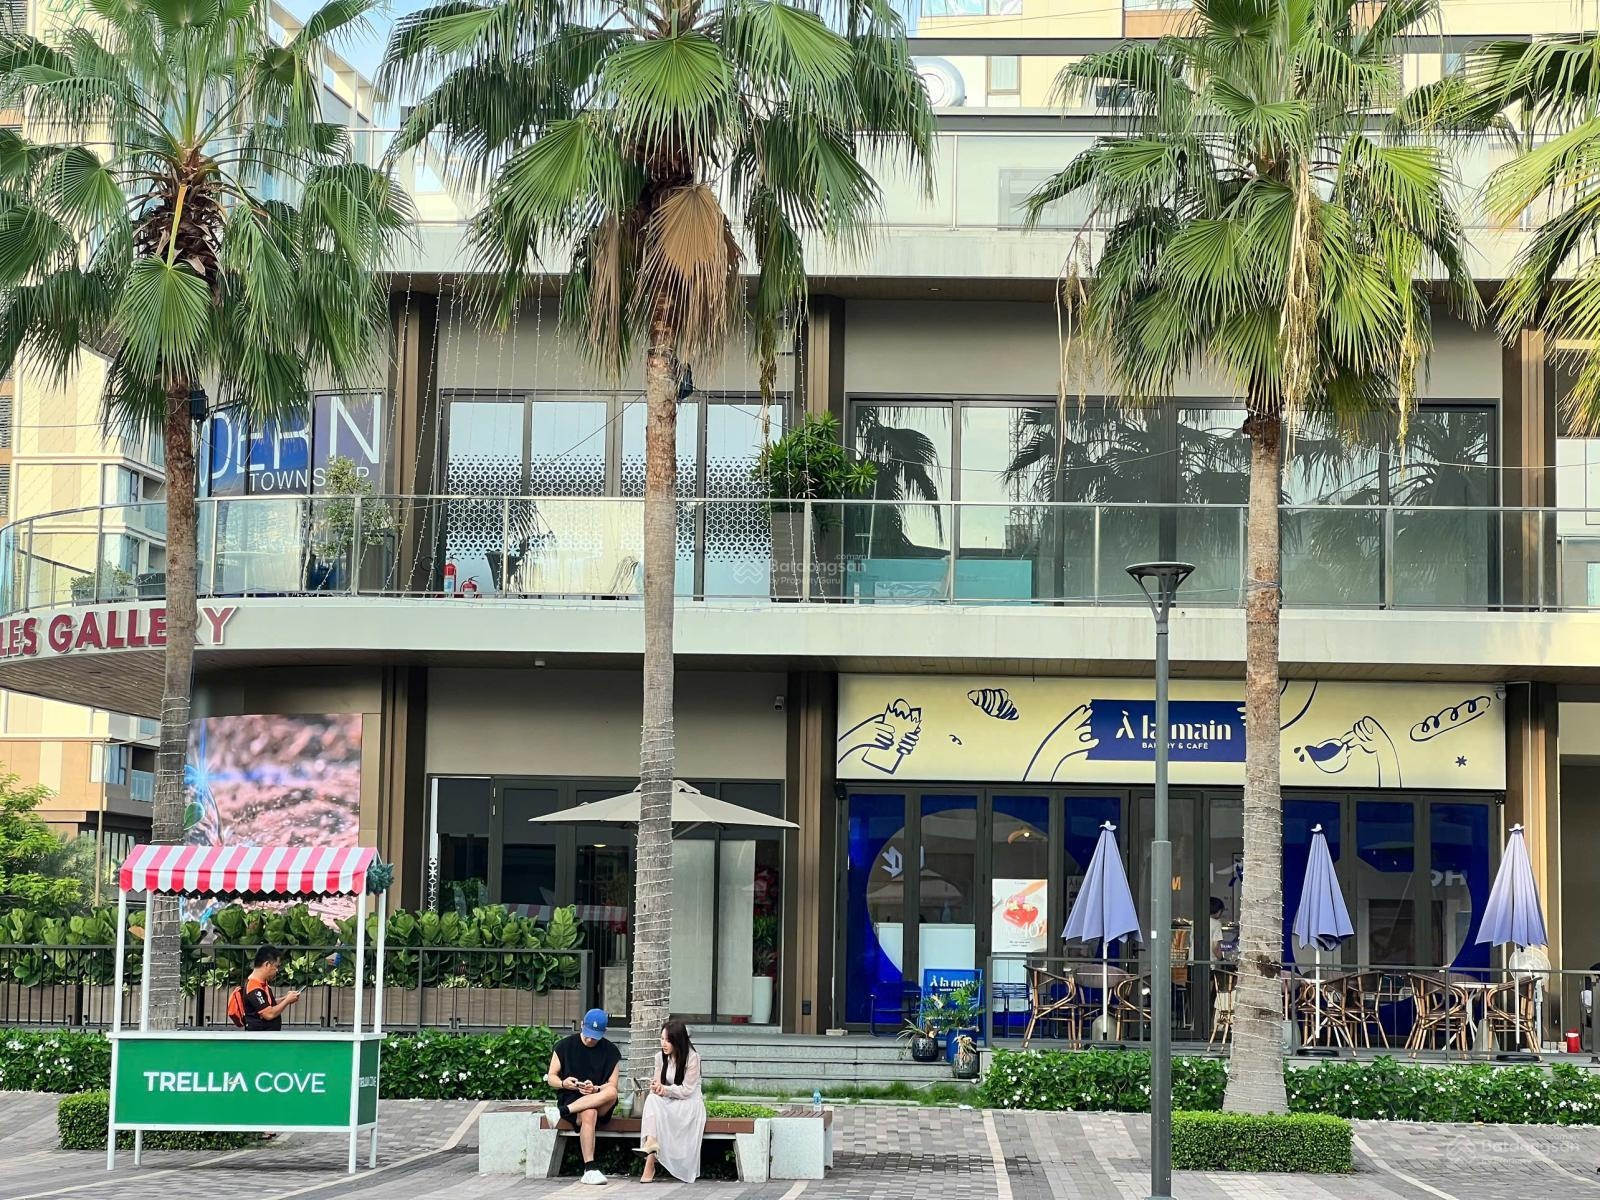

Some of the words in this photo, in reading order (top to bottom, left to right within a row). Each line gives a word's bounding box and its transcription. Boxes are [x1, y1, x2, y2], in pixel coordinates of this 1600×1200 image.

[249, 466, 370, 492] TOWNSP
[48, 605, 238, 654] GALLEY
[1115, 710, 1135, 739] À
[1171, 719, 1232, 740] main
[1186, 741, 1209, 750] CAFÉ
[143, 1071, 248, 1092] TRELLIA
[255, 1072, 326, 1093] COVE
